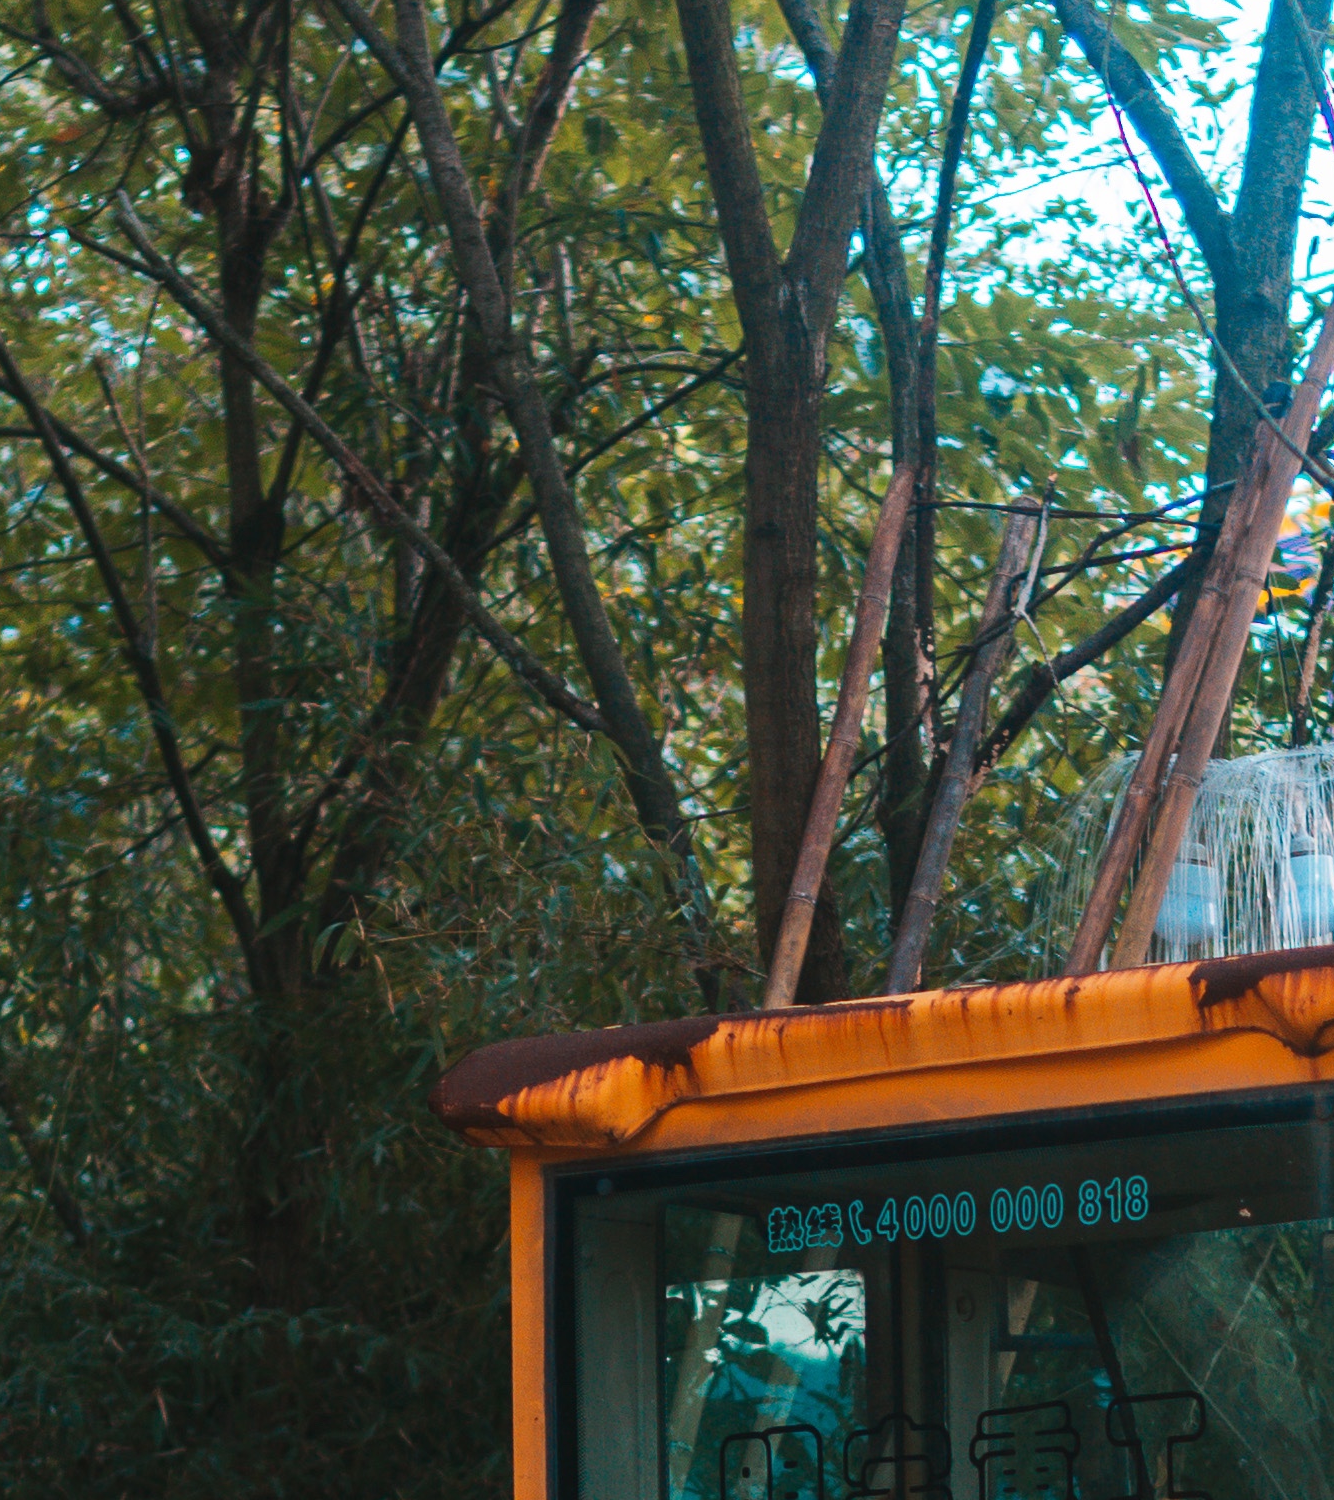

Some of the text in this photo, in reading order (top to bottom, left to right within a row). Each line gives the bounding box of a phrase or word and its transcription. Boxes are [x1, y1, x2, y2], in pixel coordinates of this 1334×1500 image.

[768, 1175, 1150, 1253] 热线 4000 000 818
